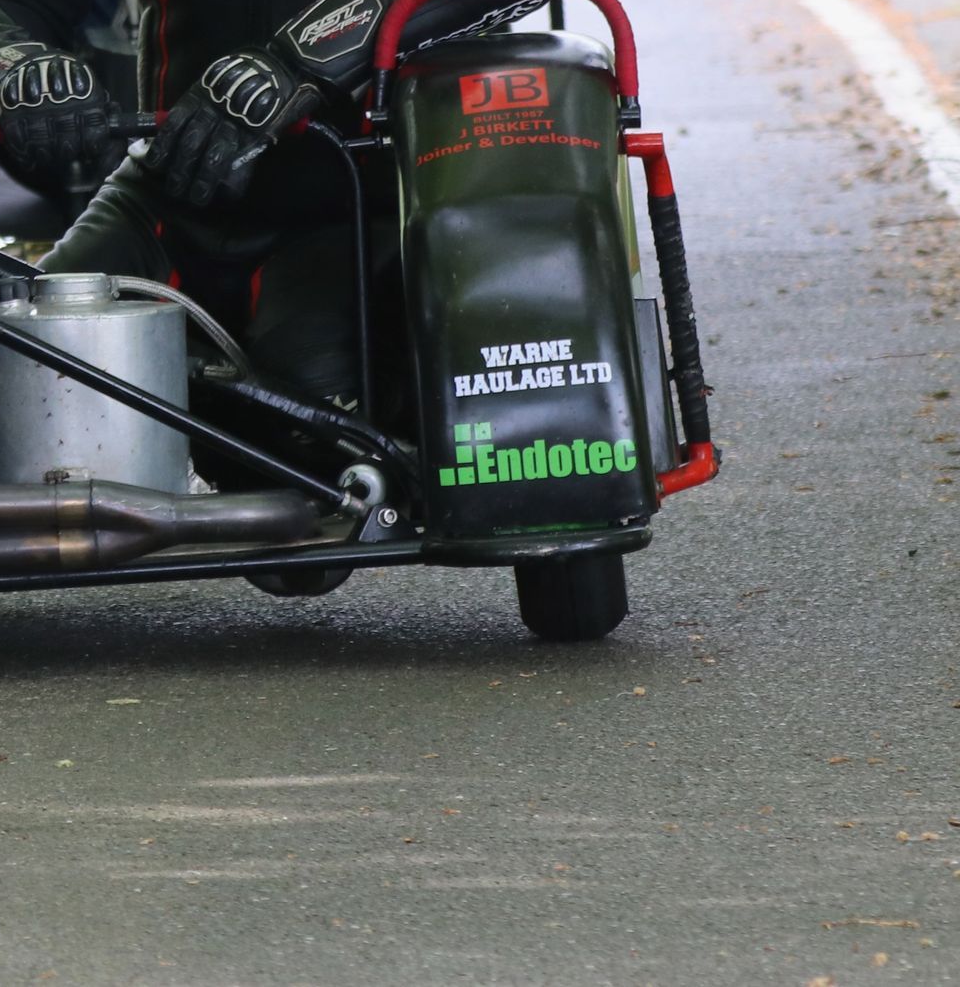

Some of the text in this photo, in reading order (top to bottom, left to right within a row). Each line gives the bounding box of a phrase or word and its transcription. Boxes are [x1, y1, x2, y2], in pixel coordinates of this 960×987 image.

[471, 73, 543, 108] JB
[459, 120, 554, 139] J BIRKETT
[473, 112, 510, 123] BUILT
[416, 133, 601, 166] Joiner & Developer
[480, 339, 573, 368] WARNE
[454, 362, 612, 397] HAULAGE LTD
[476, 439, 637, 484] Endotec
